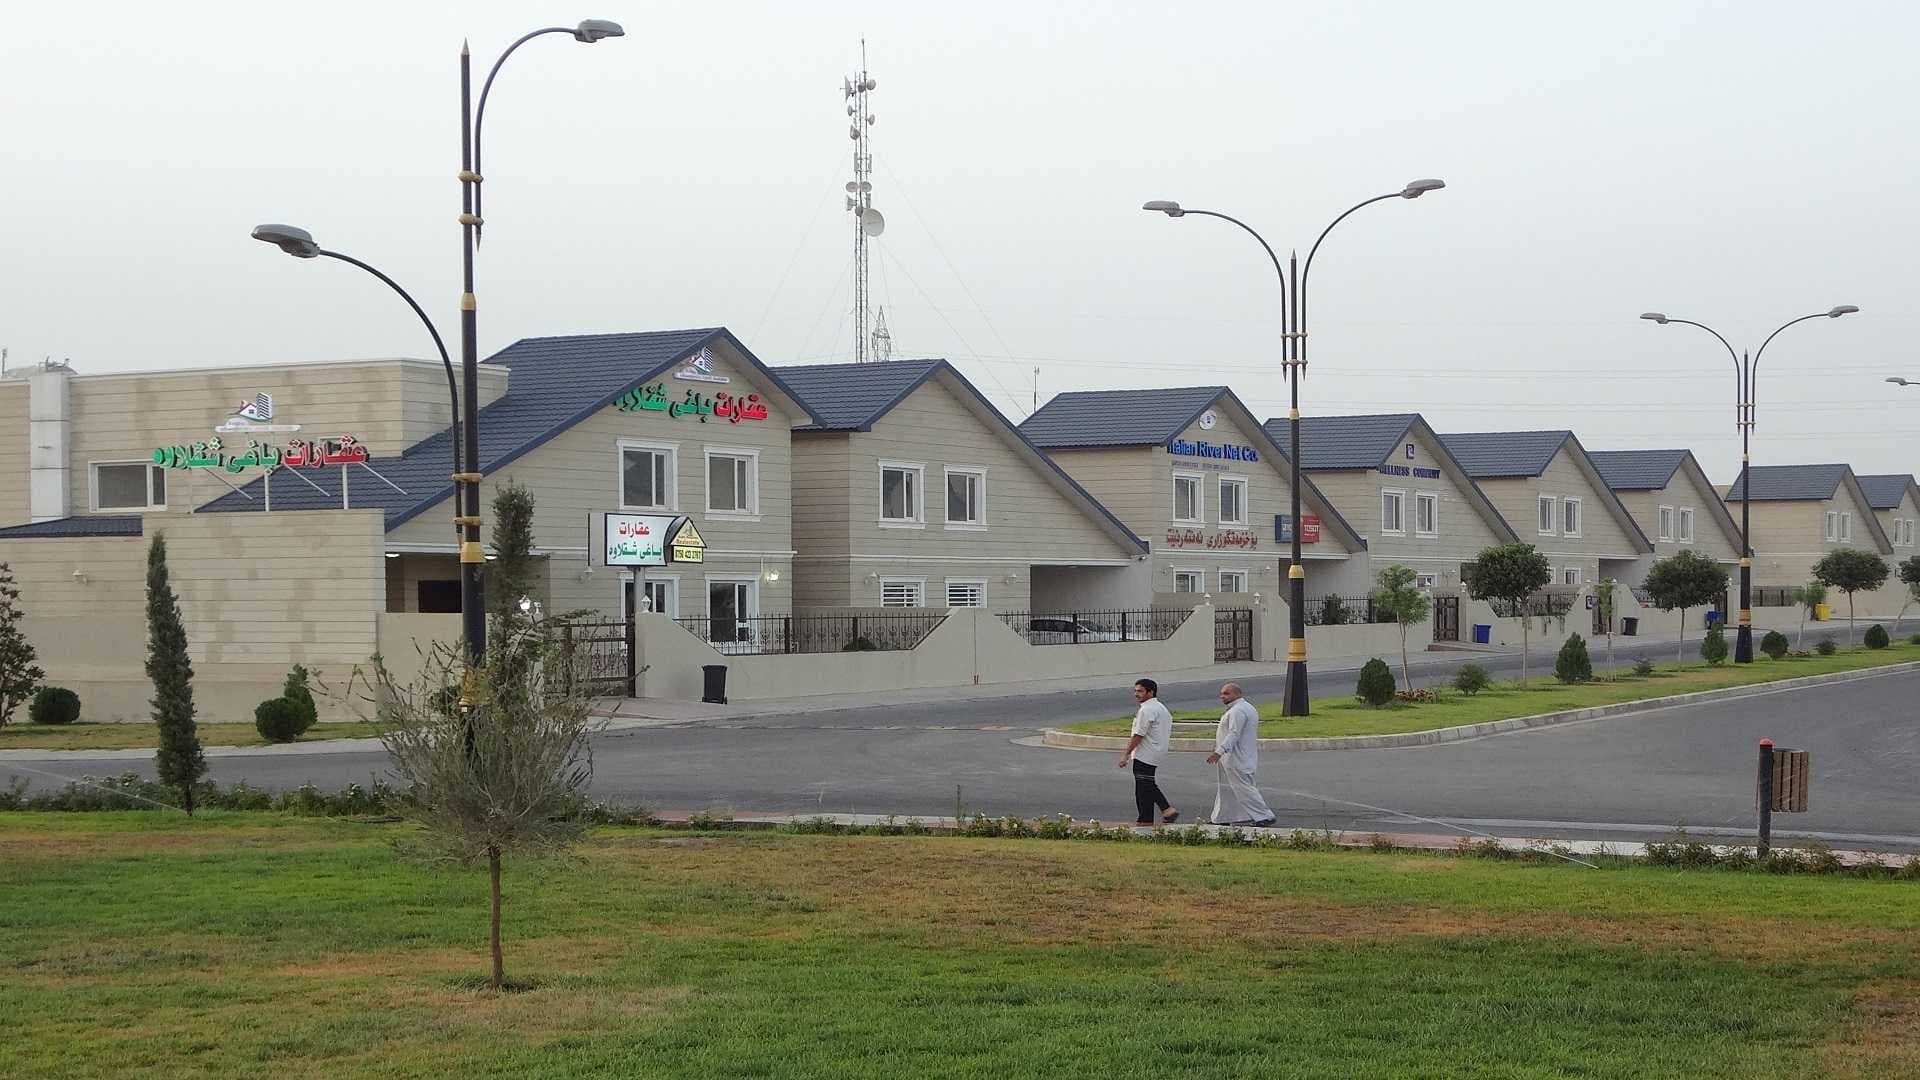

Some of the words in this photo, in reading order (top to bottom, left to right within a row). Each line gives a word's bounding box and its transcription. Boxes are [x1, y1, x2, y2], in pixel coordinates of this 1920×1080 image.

[714, 391, 768, 424] عقارات
[282, 433, 370, 468] عقارات
[1197, 441, 1221, 458] River
[1223, 444, 1240, 460] Net
[619, 521, 650, 537] عقارات
